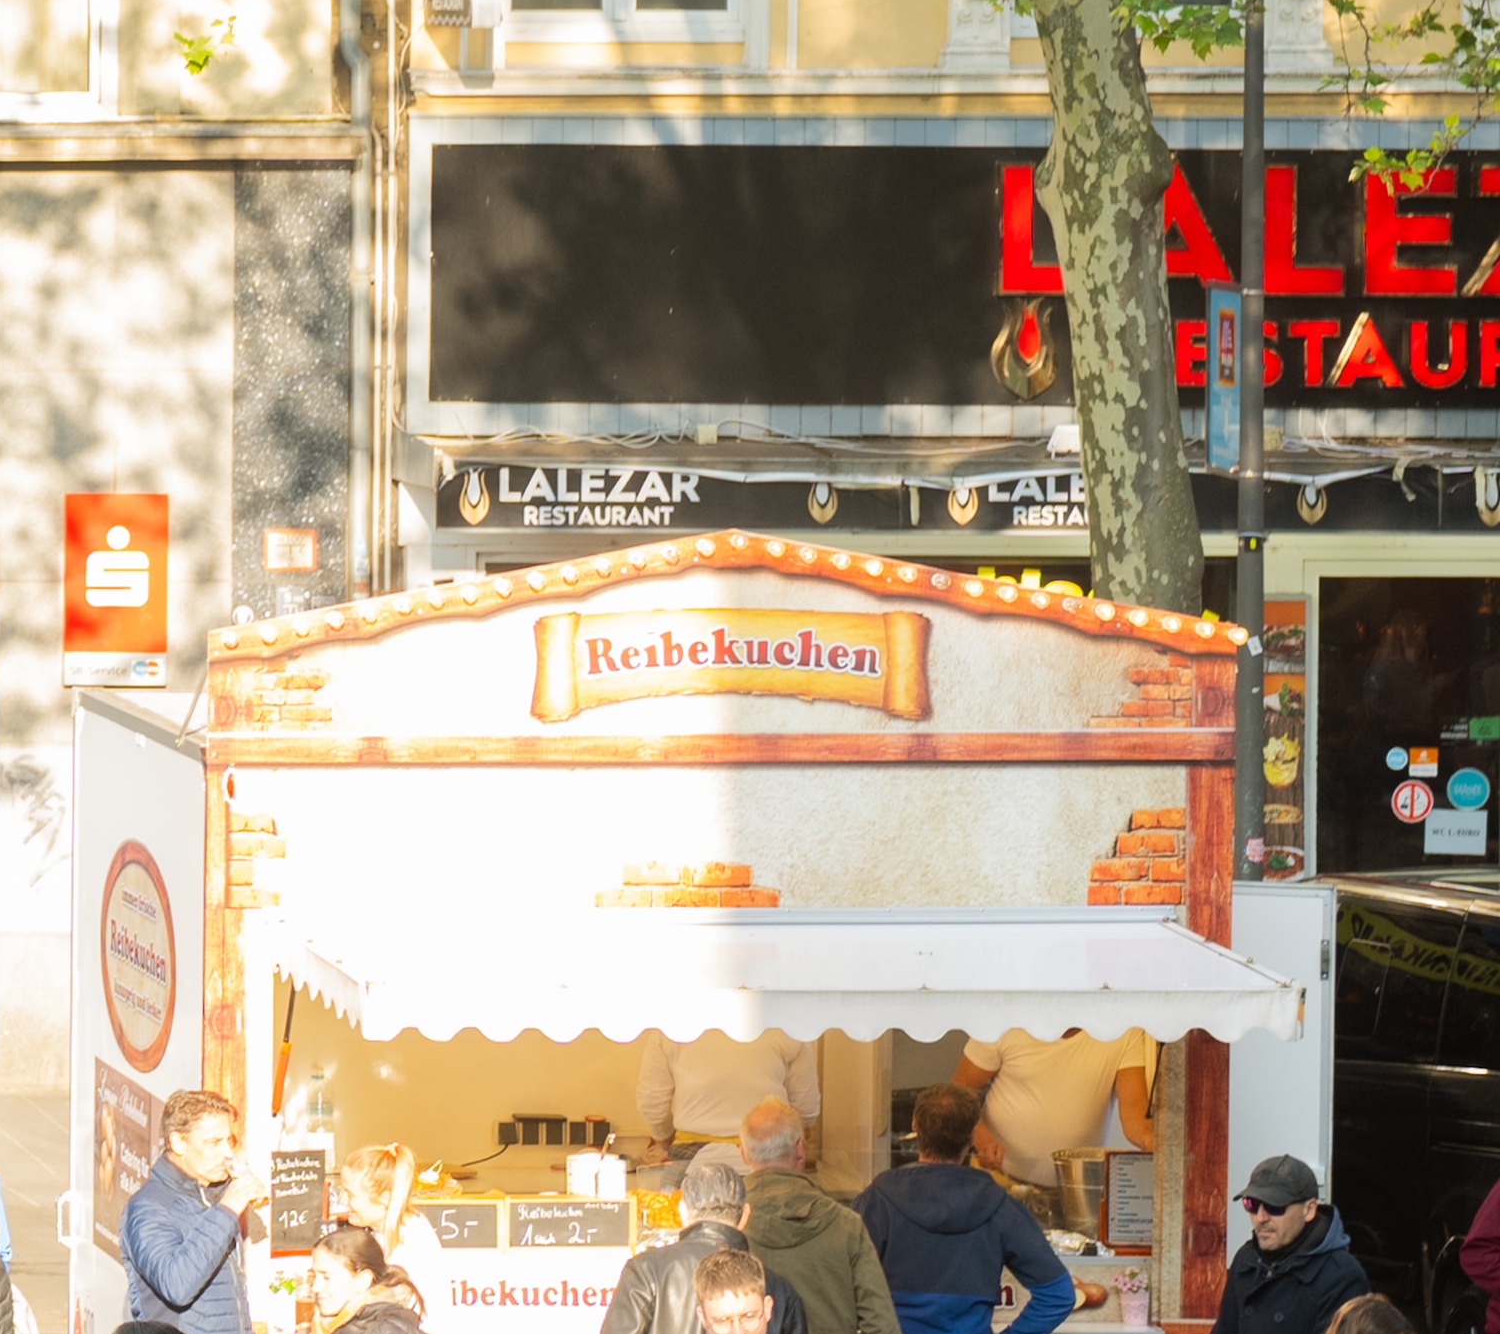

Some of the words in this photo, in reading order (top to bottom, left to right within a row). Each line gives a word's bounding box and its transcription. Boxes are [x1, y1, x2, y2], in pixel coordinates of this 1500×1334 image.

[1000, 162, 1500, 295] LALE
[500, 467, 700, 503] LALEZAR
[987, 473, 1084, 503] LALE
[522, 504, 675, 528] RESTAURANT
[585, 628, 882, 677] Reibekuchen
